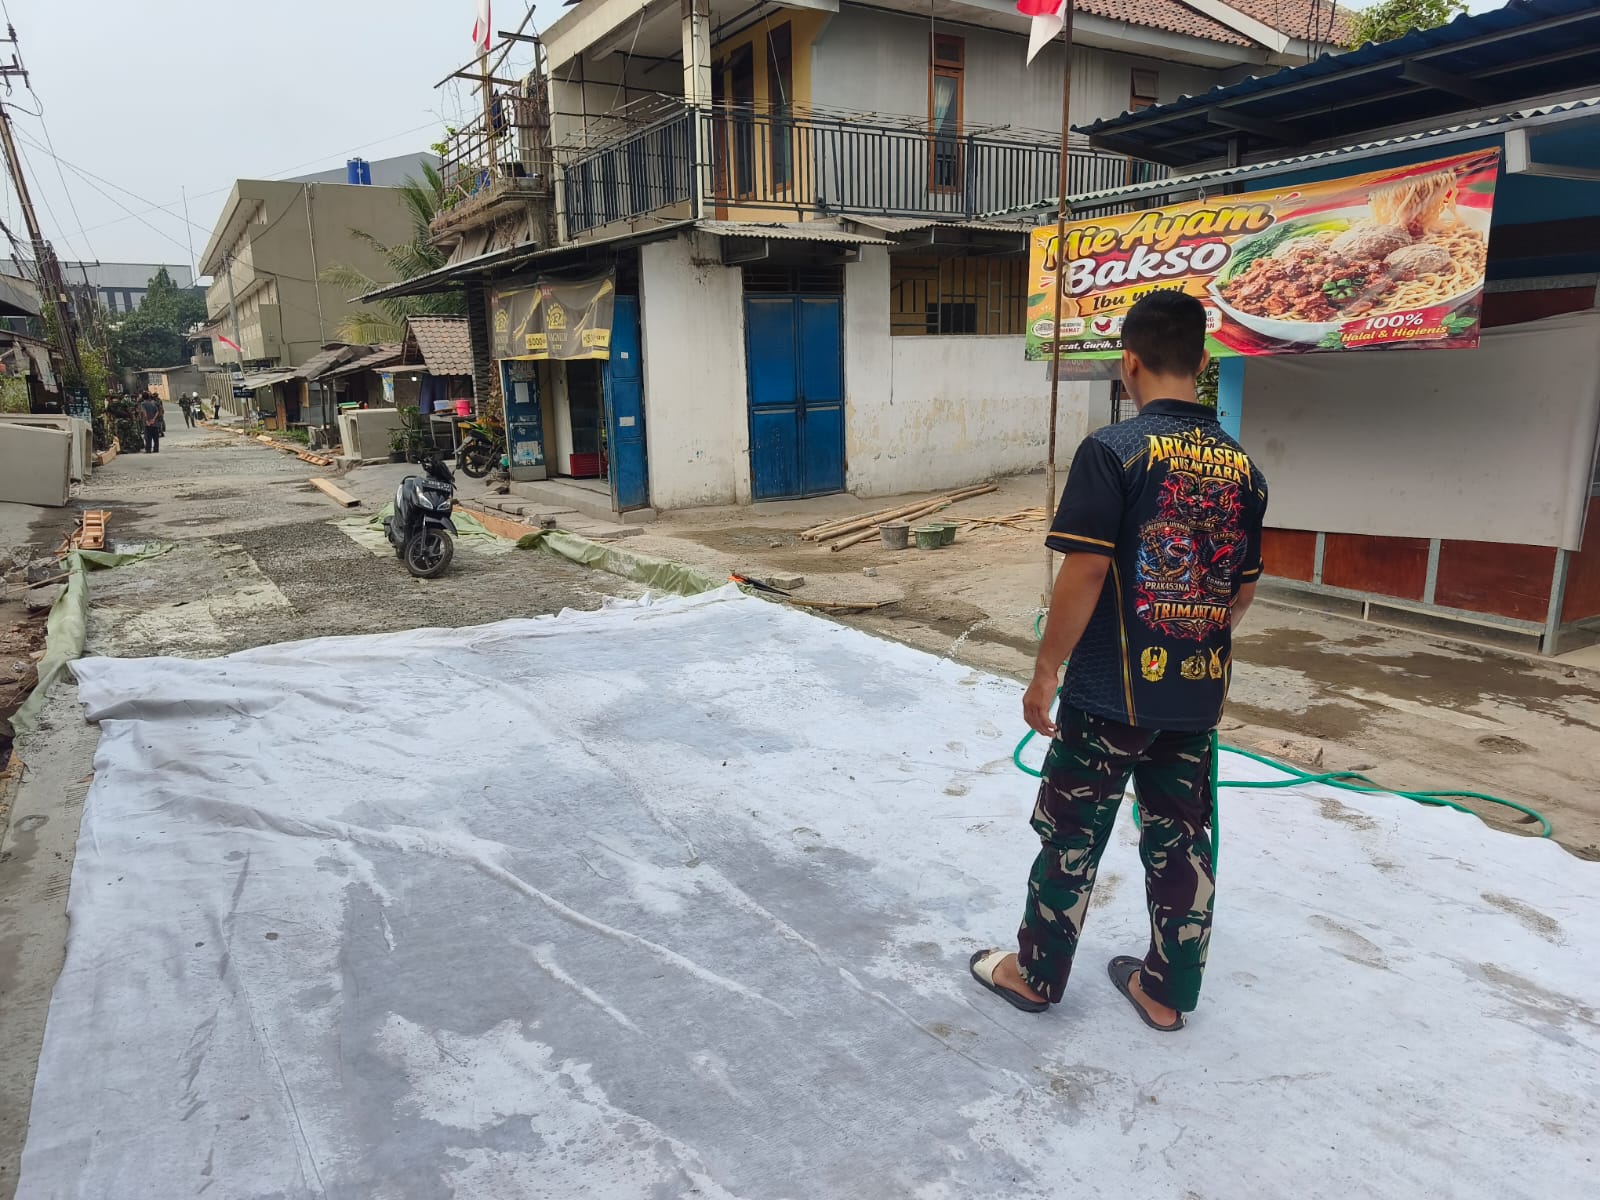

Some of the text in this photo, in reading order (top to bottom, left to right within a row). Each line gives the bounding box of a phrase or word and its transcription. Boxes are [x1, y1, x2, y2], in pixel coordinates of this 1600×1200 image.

[1044, 204, 1270, 270] Mie Ayam
[1066, 242, 1228, 295] Bakso
[1092, 294, 1126, 311] Ibu
[1365, 312, 1424, 330] 100%
[1341, 325, 1448, 342] Halal & Higienis
[1057, 342, 1081, 350] ezat,
[1083, 340, 1113, 350] Gurih,
[1167, 457, 1242, 482] NUSANTARA
[1144, 581, 1190, 592] PRAK453NA
